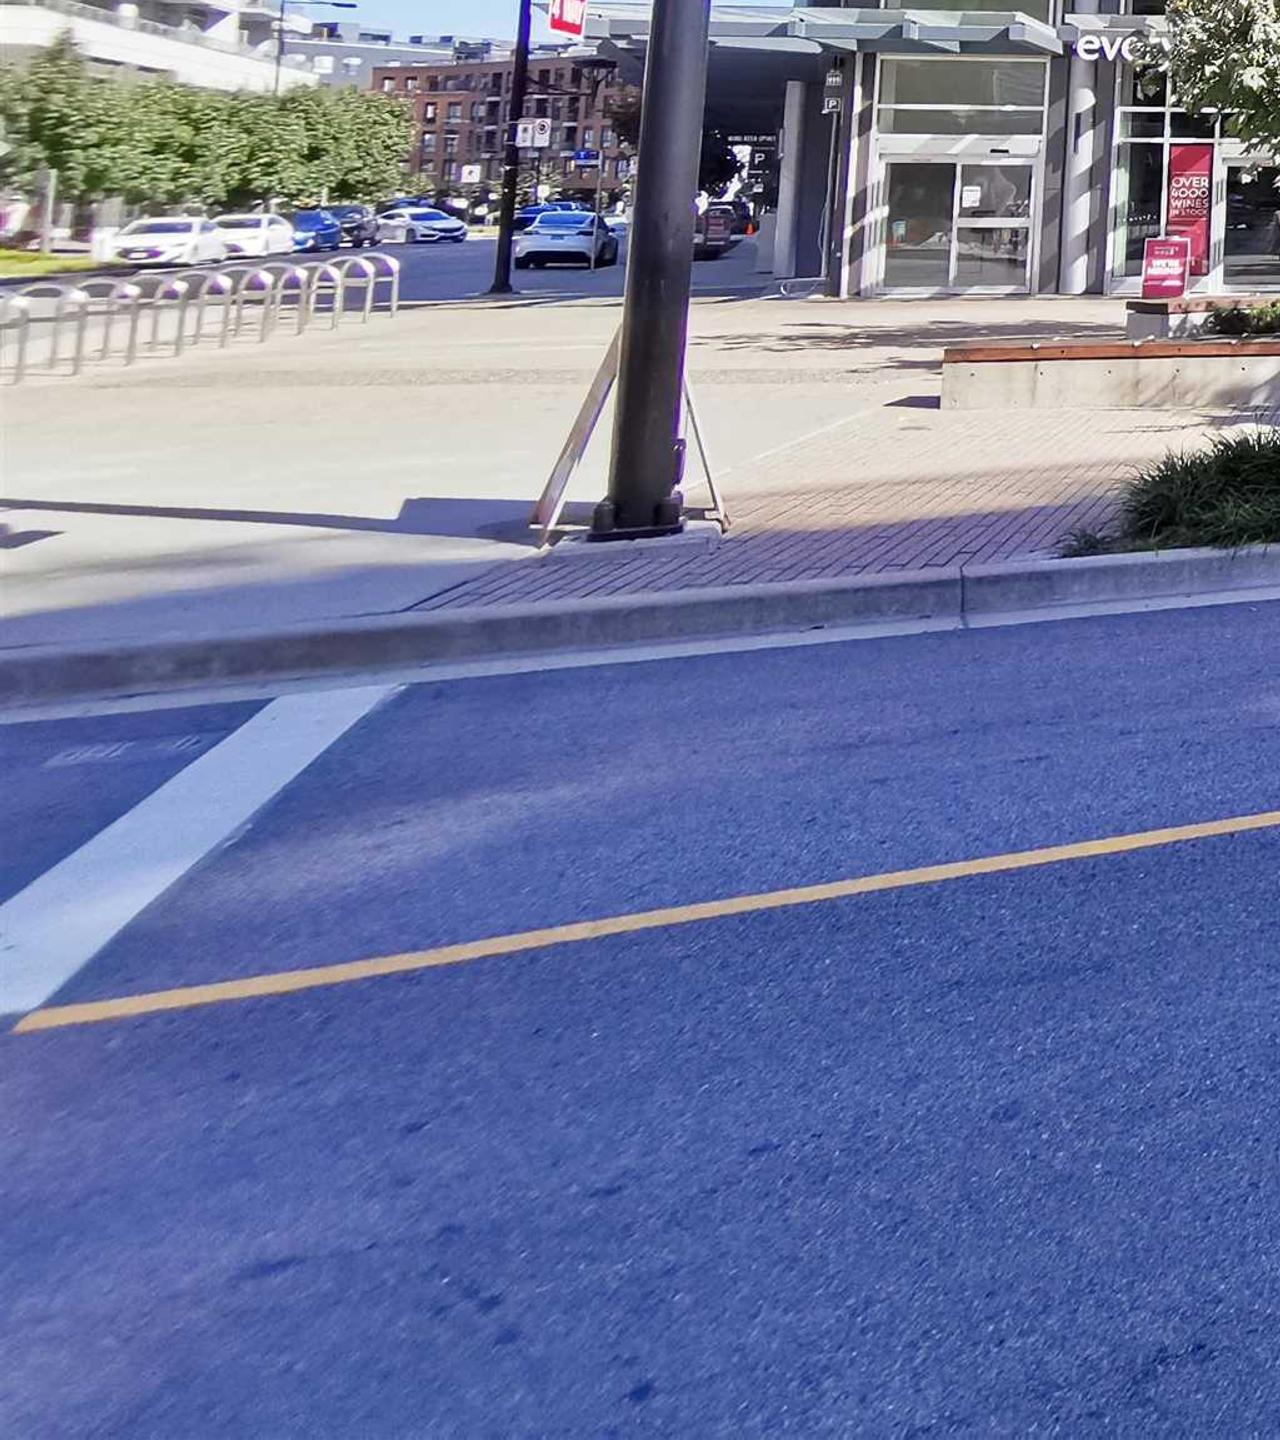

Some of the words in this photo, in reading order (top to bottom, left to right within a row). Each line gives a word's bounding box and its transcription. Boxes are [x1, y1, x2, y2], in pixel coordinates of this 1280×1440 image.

[828, 99, 837, 109] P
[754, 153, 766, 165] P
[1171, 176, 1209, 188] OVER
[1171, 188, 1209, 198] 4000
[1171, 199, 1209, 209] WINES
[1170, 208, 1179, 216] IN
